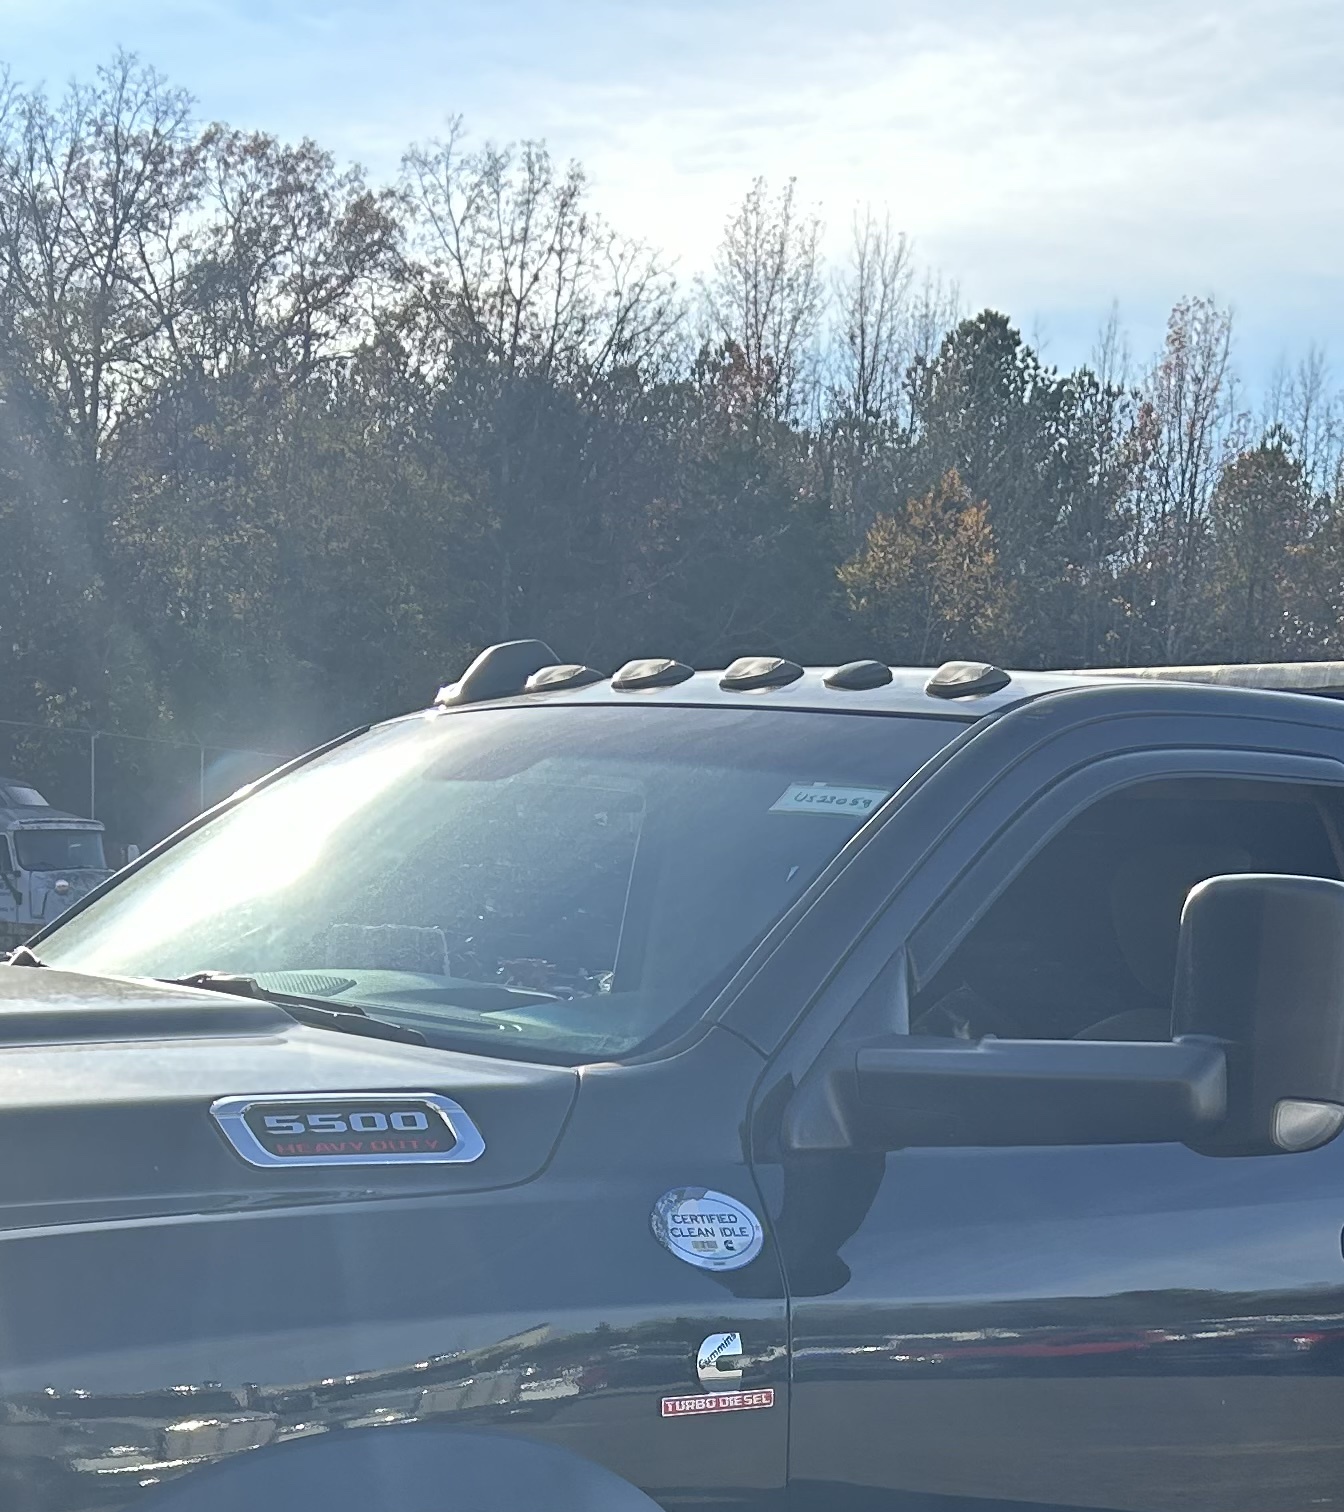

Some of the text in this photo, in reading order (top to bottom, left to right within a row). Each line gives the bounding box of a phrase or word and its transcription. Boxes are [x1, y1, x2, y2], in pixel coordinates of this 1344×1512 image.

[263, 1111, 429, 1135] 5500
[274, 1138, 440, 1155] HEAVY DUTY
[671, 1213, 738, 1224] CERTIFIED
[670, 1226, 749, 1238] CLEAN IDLE
[698, 1332, 738, 1370] Cummins
[665, 1392, 771, 1412] TURBO DIESEL
